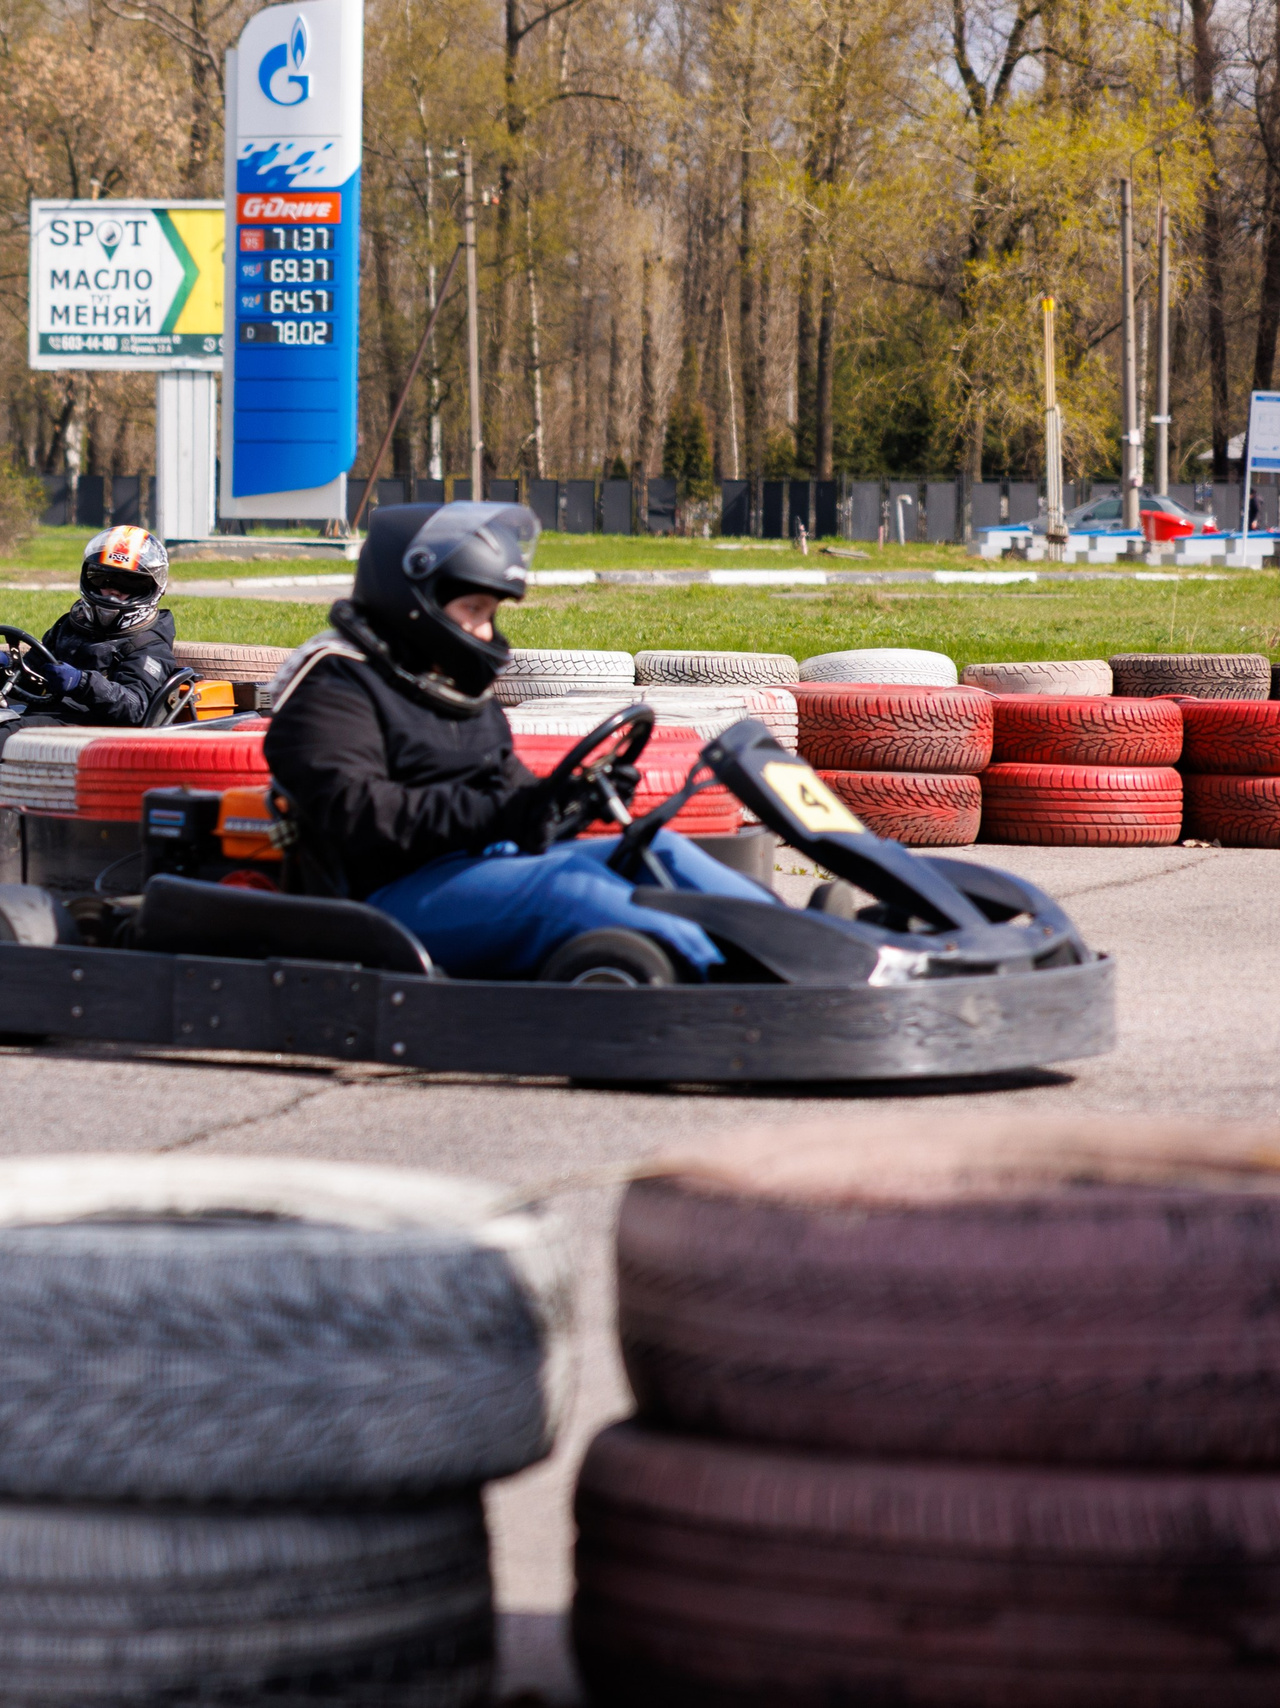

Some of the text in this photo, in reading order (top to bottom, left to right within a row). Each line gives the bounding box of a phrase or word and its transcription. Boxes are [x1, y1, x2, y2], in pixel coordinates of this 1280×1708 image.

[50, 269, 152, 290] МАСЛО
[242, 265, 255, 277] 95
[242, 296, 255, 308] 92
[50, 298, 151, 326] МЕНЯЙ
[246, 326, 255, 339] D
[799, 782, 831, 814] 4
